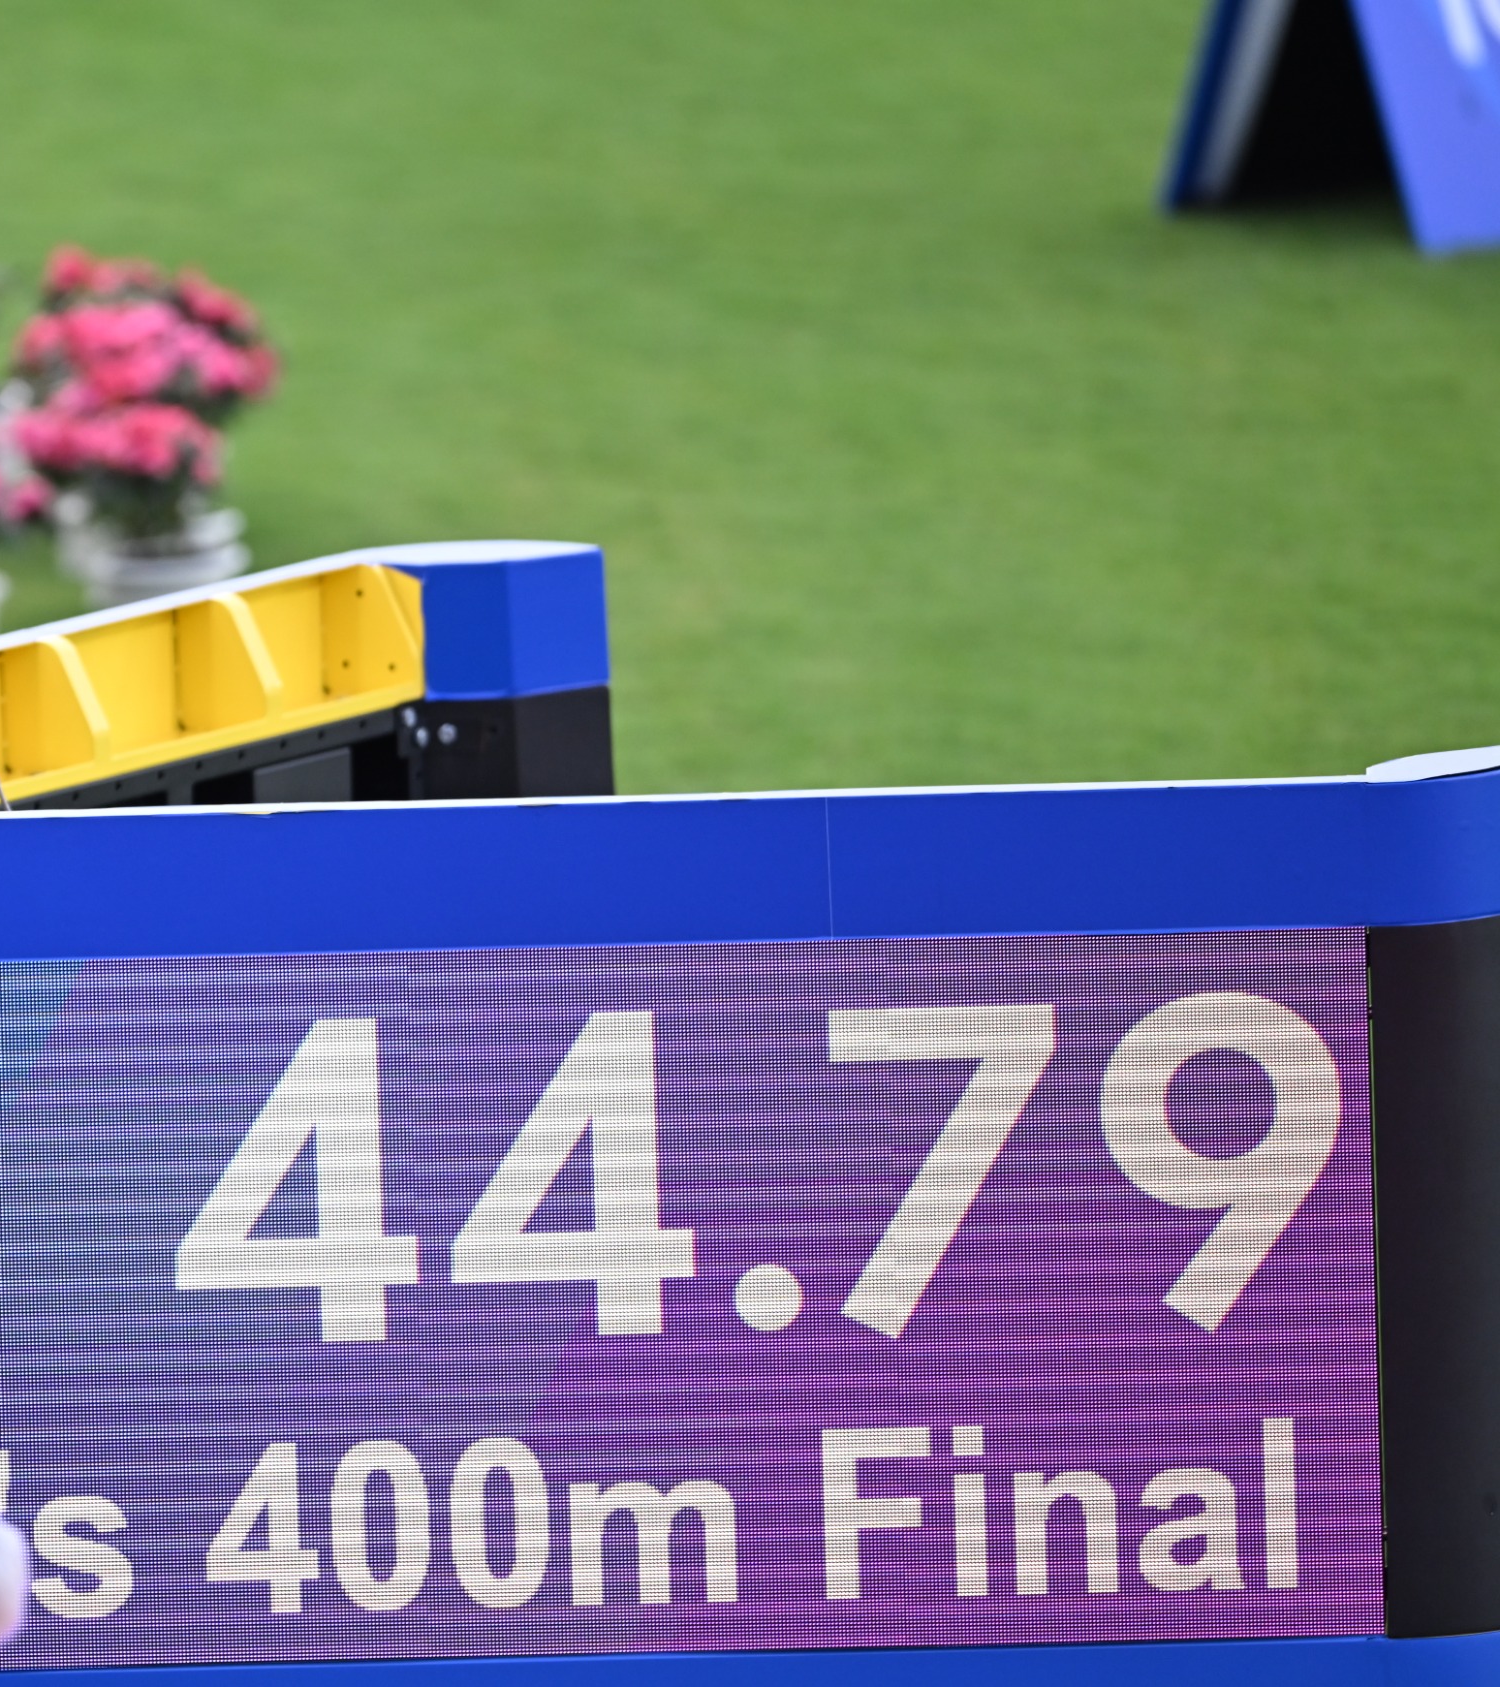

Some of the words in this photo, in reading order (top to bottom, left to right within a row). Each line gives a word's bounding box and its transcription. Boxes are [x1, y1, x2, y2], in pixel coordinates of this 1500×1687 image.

[174, 991, 1341, 1342] 44.79
[206, 1436, 739, 1613] 400m
[821, 1417, 1300, 1602] Final
